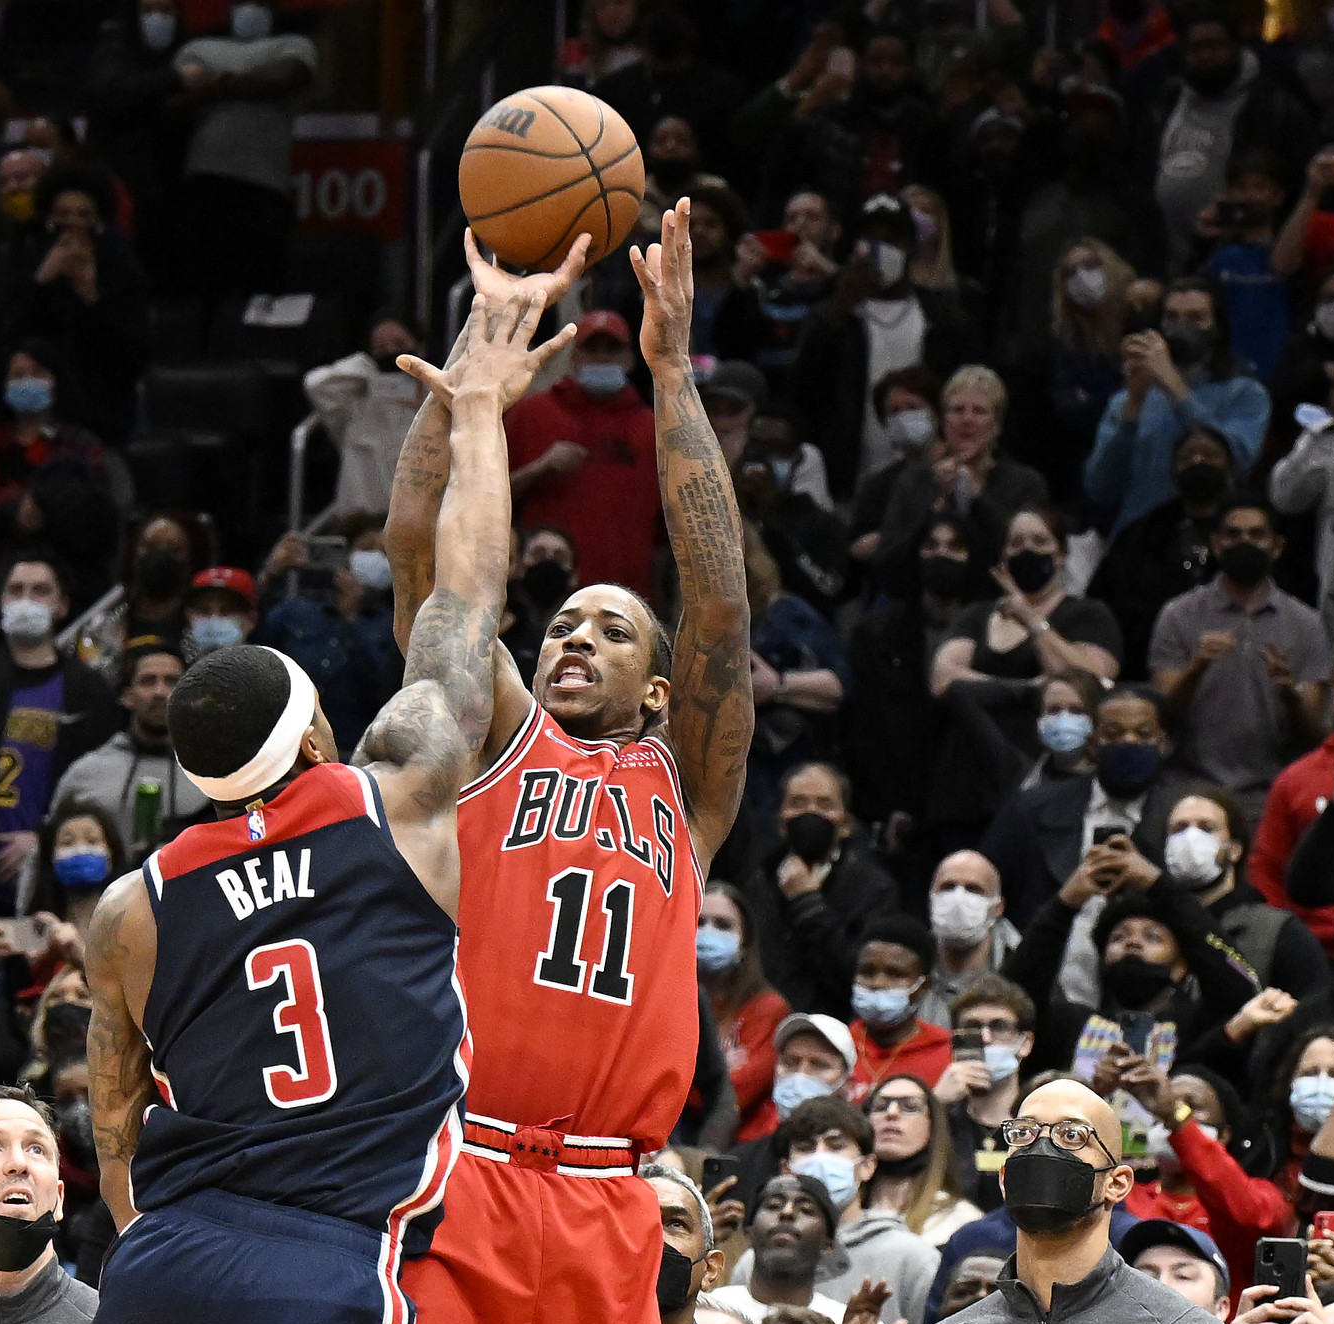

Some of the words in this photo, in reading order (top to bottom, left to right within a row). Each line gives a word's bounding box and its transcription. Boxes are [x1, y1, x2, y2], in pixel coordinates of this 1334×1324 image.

[289, 167, 386, 221] 100
[215, 847, 316, 921] BEAL
[533, 865, 634, 1007] 11
[244, 937, 338, 1110] 3
